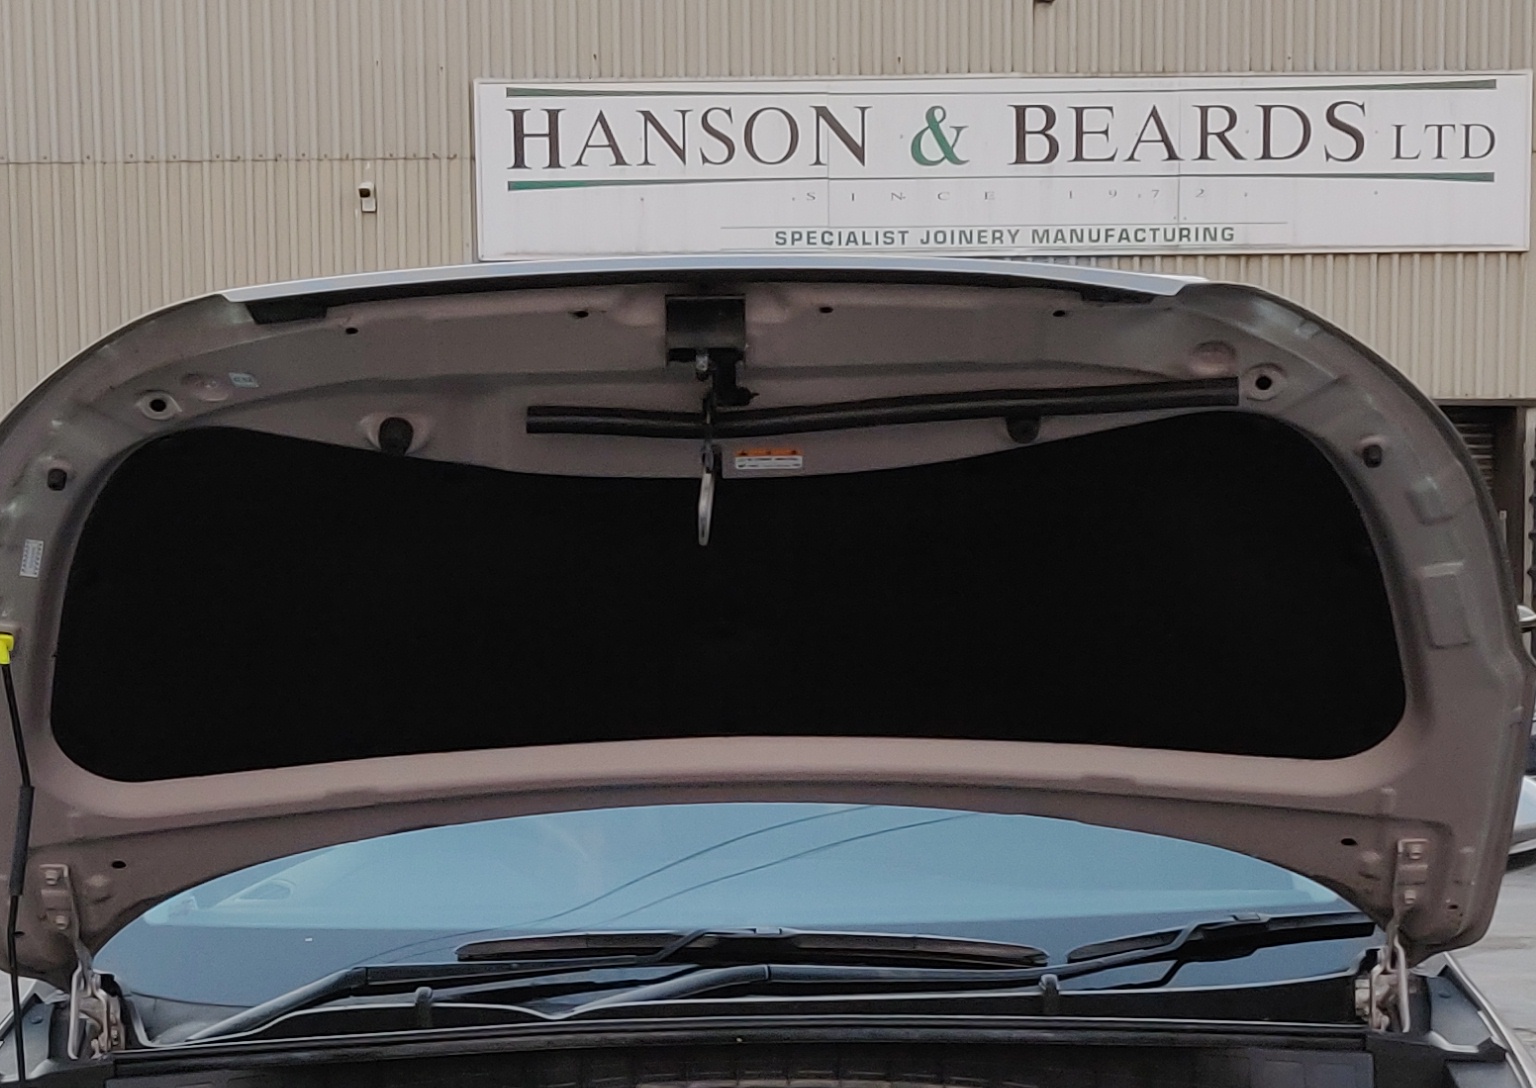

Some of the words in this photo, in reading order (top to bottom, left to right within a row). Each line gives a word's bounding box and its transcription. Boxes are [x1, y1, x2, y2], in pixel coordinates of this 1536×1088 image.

[505, 104, 873, 170] HANSON
[910, 105, 970, 167] &
[1007, 100, 1366, 166] BEARDS
[1390, 123, 1496, 161] LTD
[774, 230, 910, 246] SPECIALIST
[919, 229, 1021, 246] JOINERY
[1031, 226, 1236, 245] MANUFACTURING
